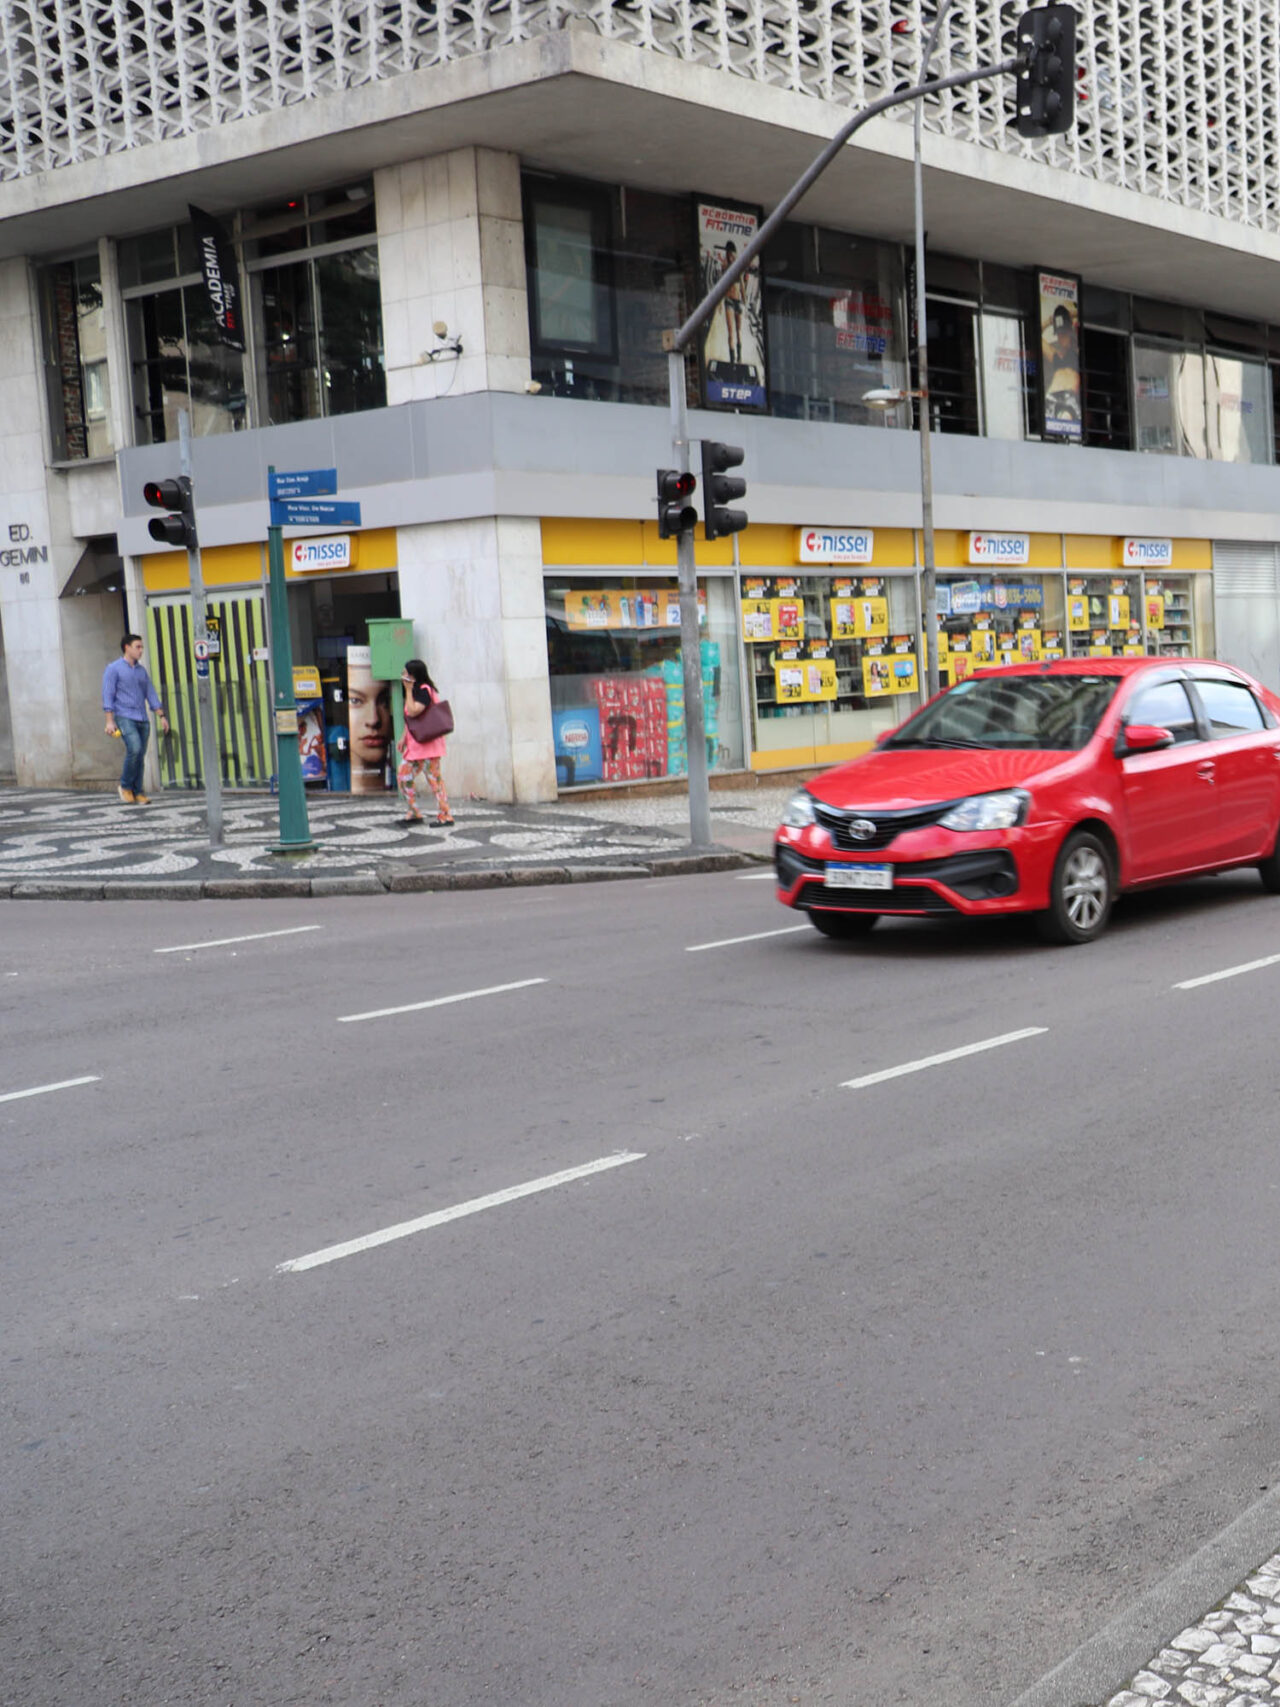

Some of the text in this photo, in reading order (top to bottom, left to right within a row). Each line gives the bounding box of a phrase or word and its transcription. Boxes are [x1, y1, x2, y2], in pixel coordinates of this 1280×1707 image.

[202, 236, 226, 328] ACADEMIA
[8, 523, 34, 542] ED.
[308, 542, 347, 561] nissei
[822, 534, 868, 553] nissei
[987, 538, 1025, 555] nissei
[1138, 543, 1169, 558] nissei
[0, 545, 49, 567] GEMINI
